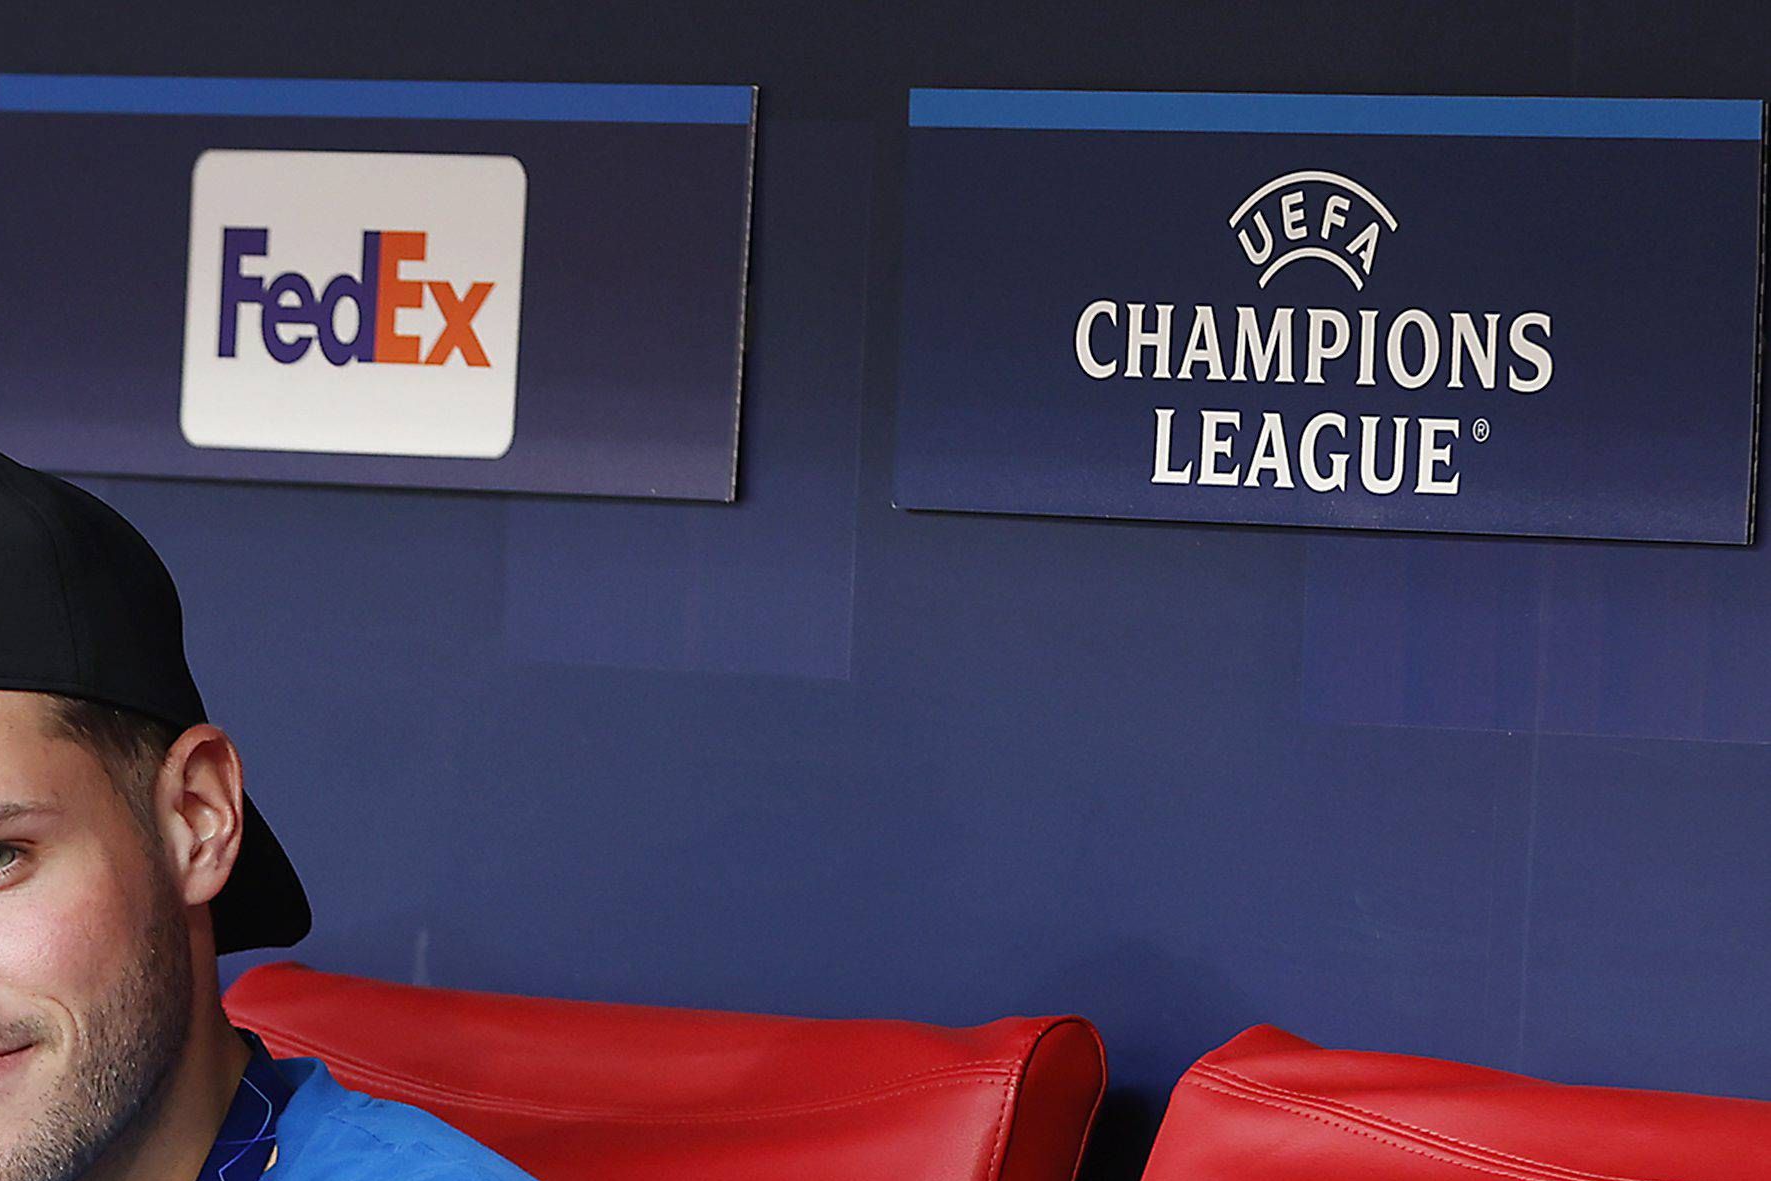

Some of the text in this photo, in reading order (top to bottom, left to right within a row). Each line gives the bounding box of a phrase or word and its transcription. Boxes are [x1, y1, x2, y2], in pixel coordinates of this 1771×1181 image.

[1236, 190, 1381, 275] UEFA
[217, 226, 495, 368] FedEx
[1074, 300, 1554, 393] CHAMPIONS
